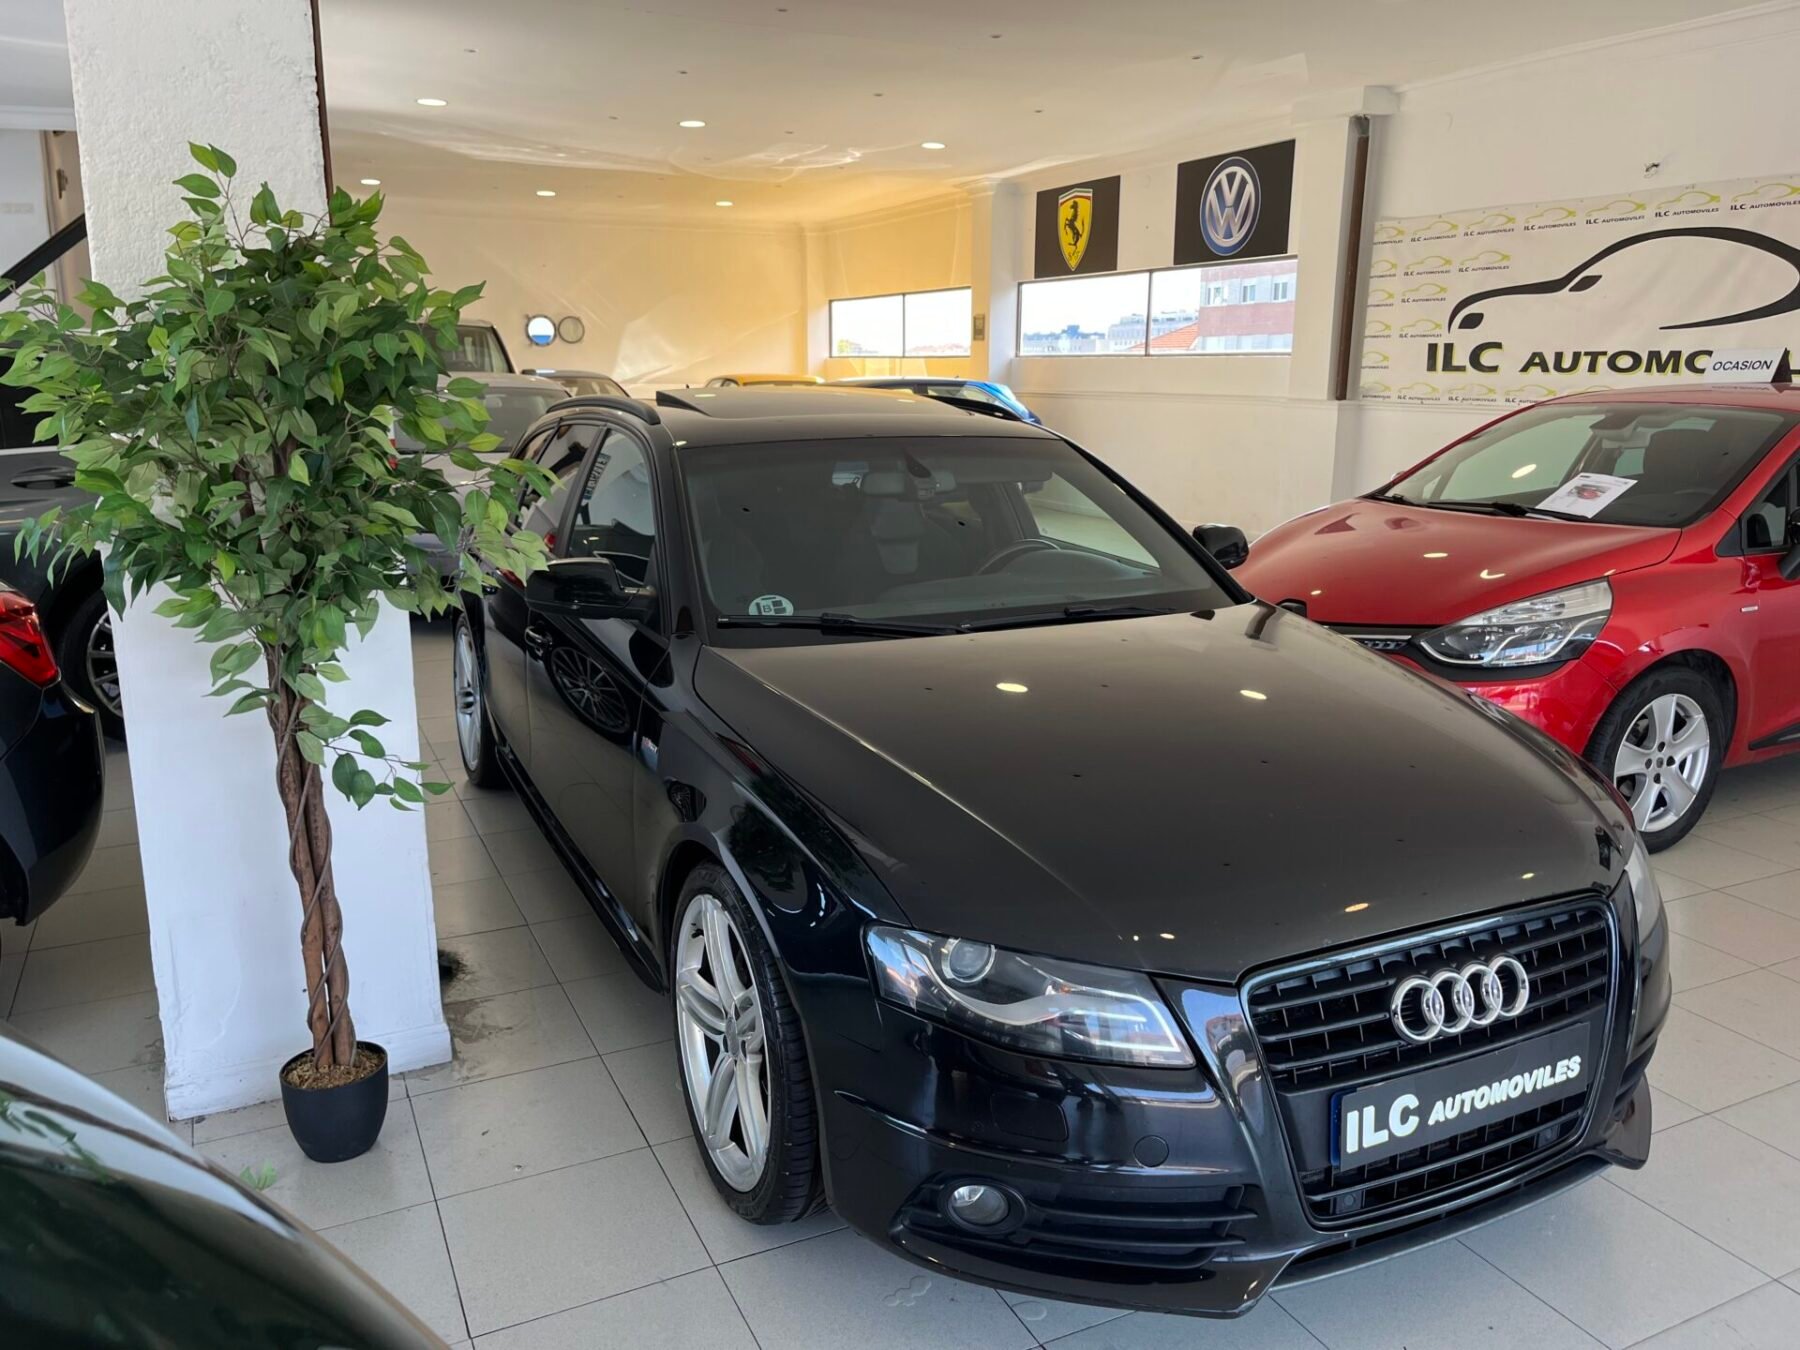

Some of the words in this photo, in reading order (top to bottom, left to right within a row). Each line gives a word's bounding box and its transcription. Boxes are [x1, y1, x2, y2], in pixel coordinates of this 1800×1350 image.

[1655, 210, 1670, 218] ILC
[1672, 207, 1719, 216] AUTOMOVILES
[1730, 203, 1746, 211] ILC
[1601, 215, 1645, 223] AUTOMOVILES
[1537, 222, 1576, 230] AUTOMOVILES
[1426, 342, 1503, 374] ILC
[1712, 360, 1773, 371] OCASION
[1346, 1093, 1420, 1154] ILC
[1427, 1055, 1582, 1126] AUTOMOVILES
